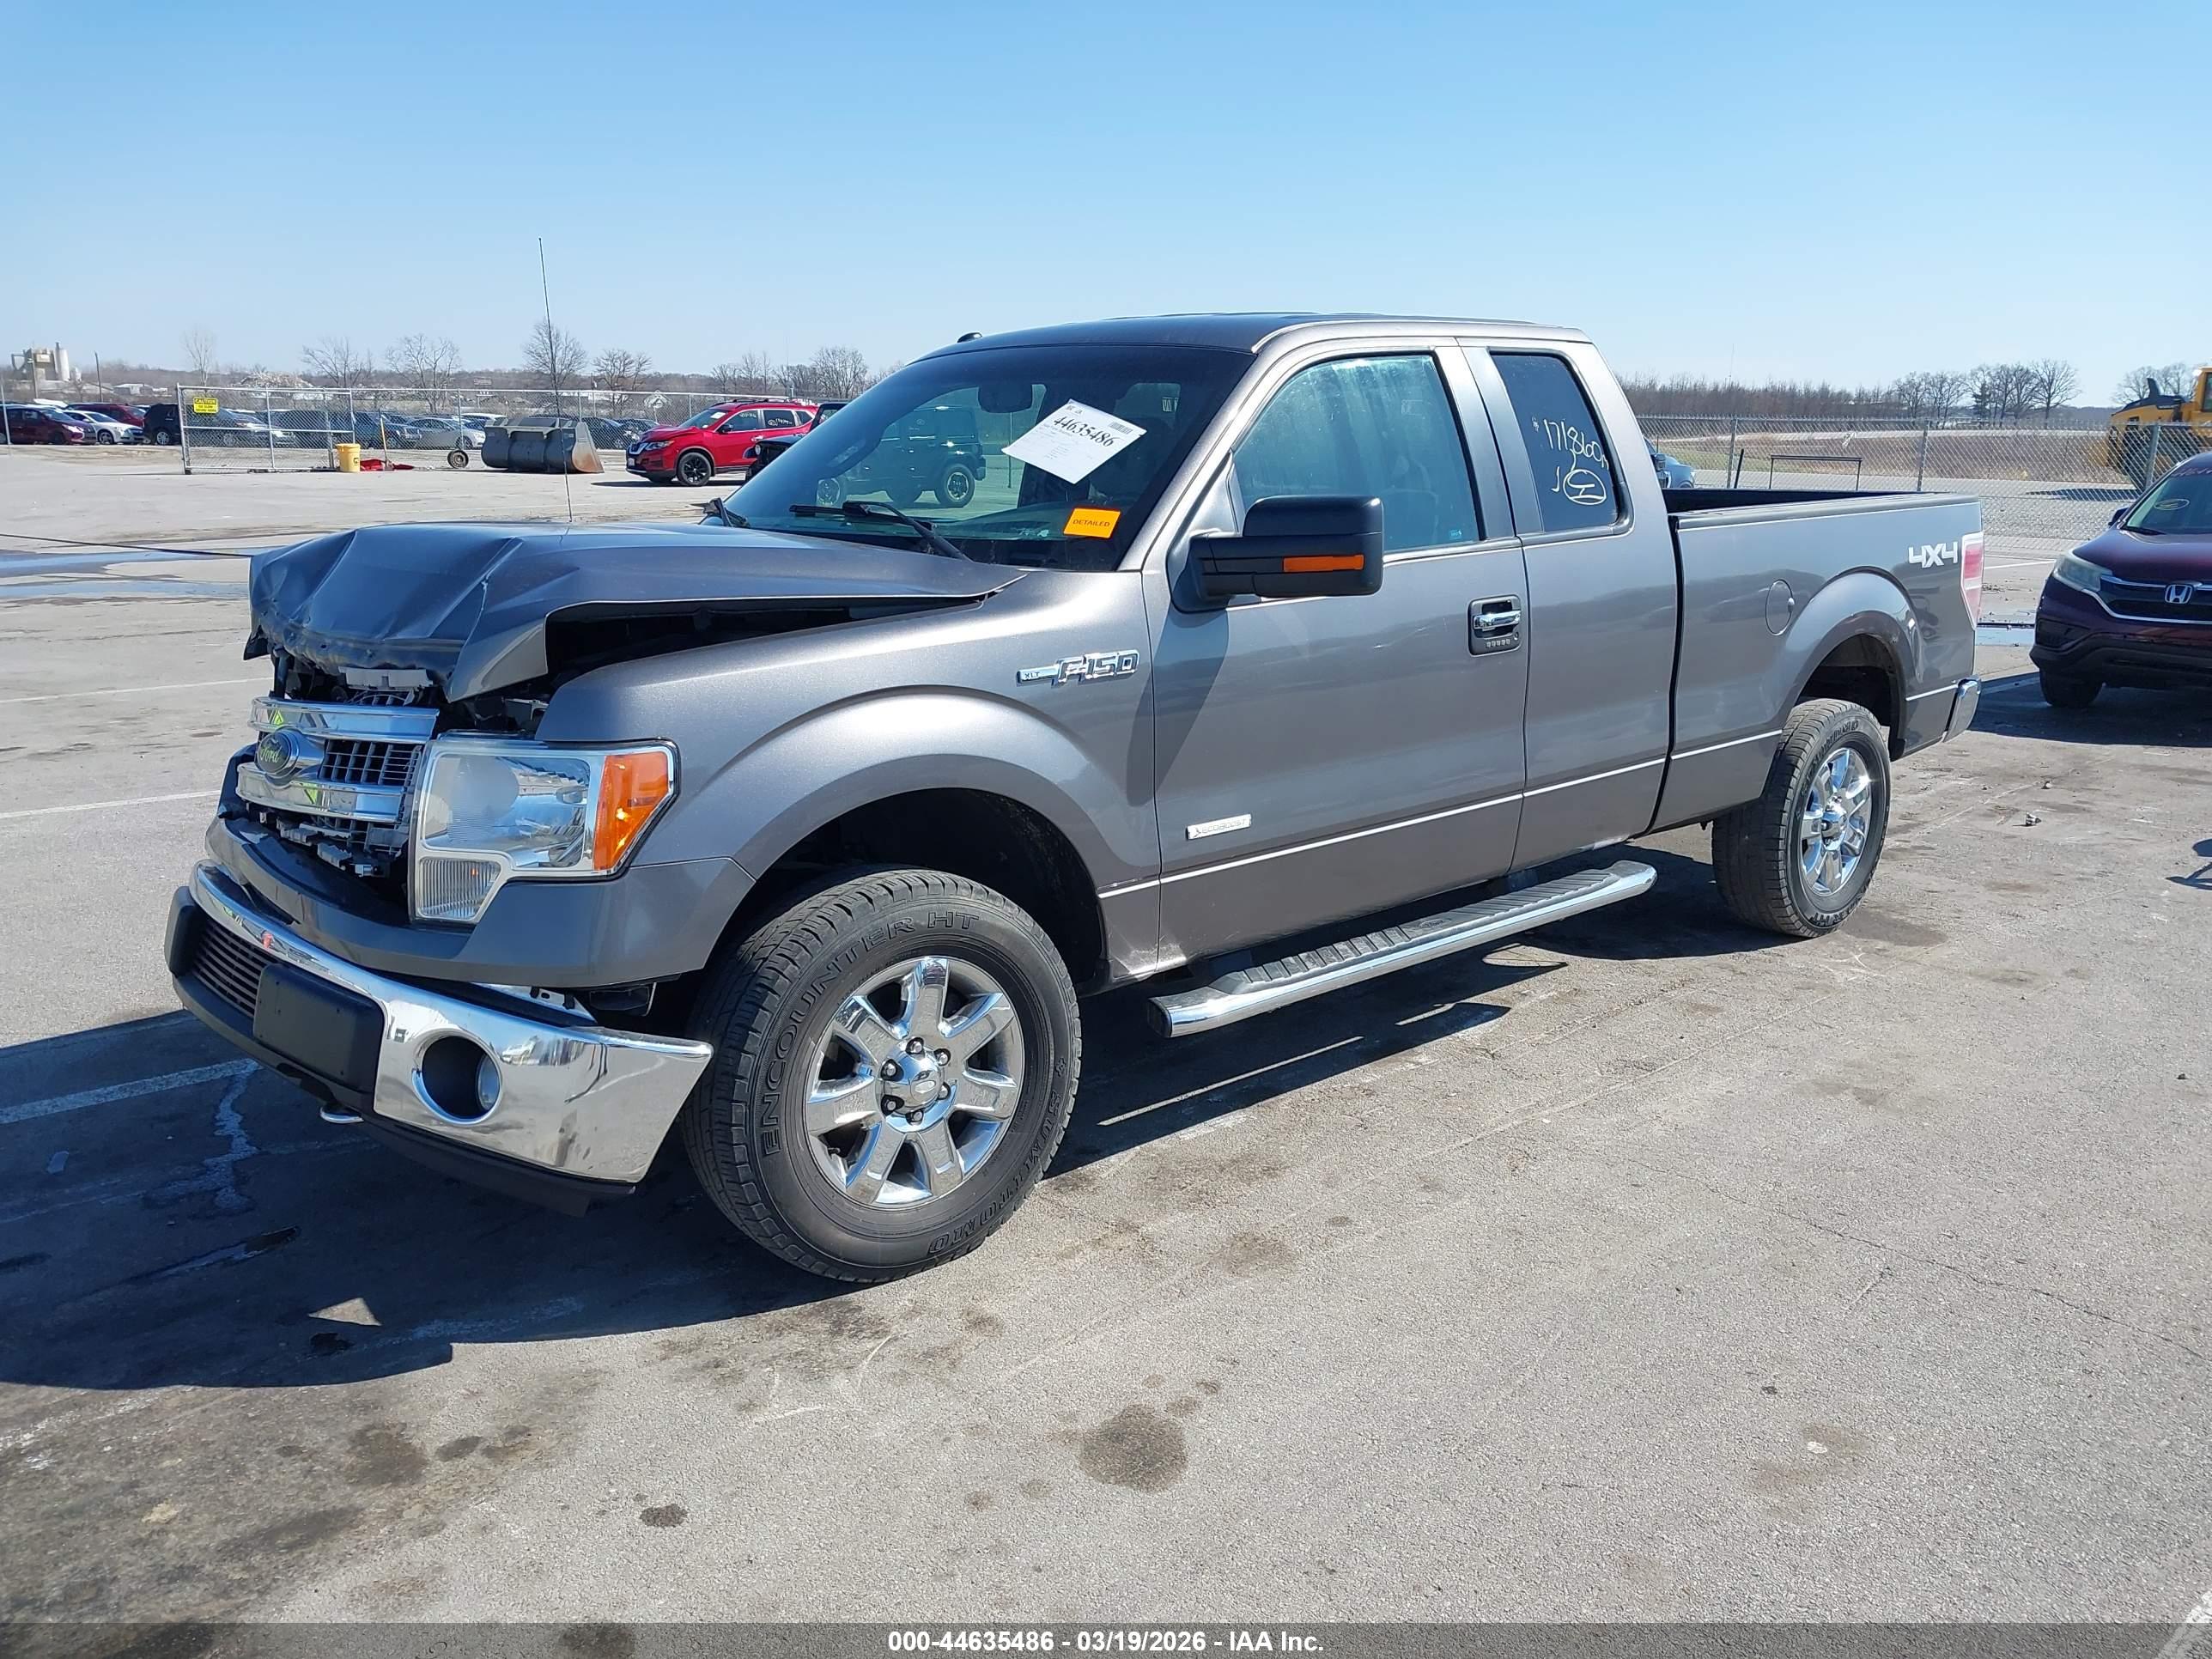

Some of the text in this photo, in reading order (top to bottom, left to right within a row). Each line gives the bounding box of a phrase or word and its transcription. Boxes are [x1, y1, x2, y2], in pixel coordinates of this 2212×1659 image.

[1054, 416, 1120, 447] 44635486
[1073, 519, 1110, 527] DETAILED
[259, 744, 283, 763] Ford
[761, 910, 980, 1157] ENCOUNTER HT
